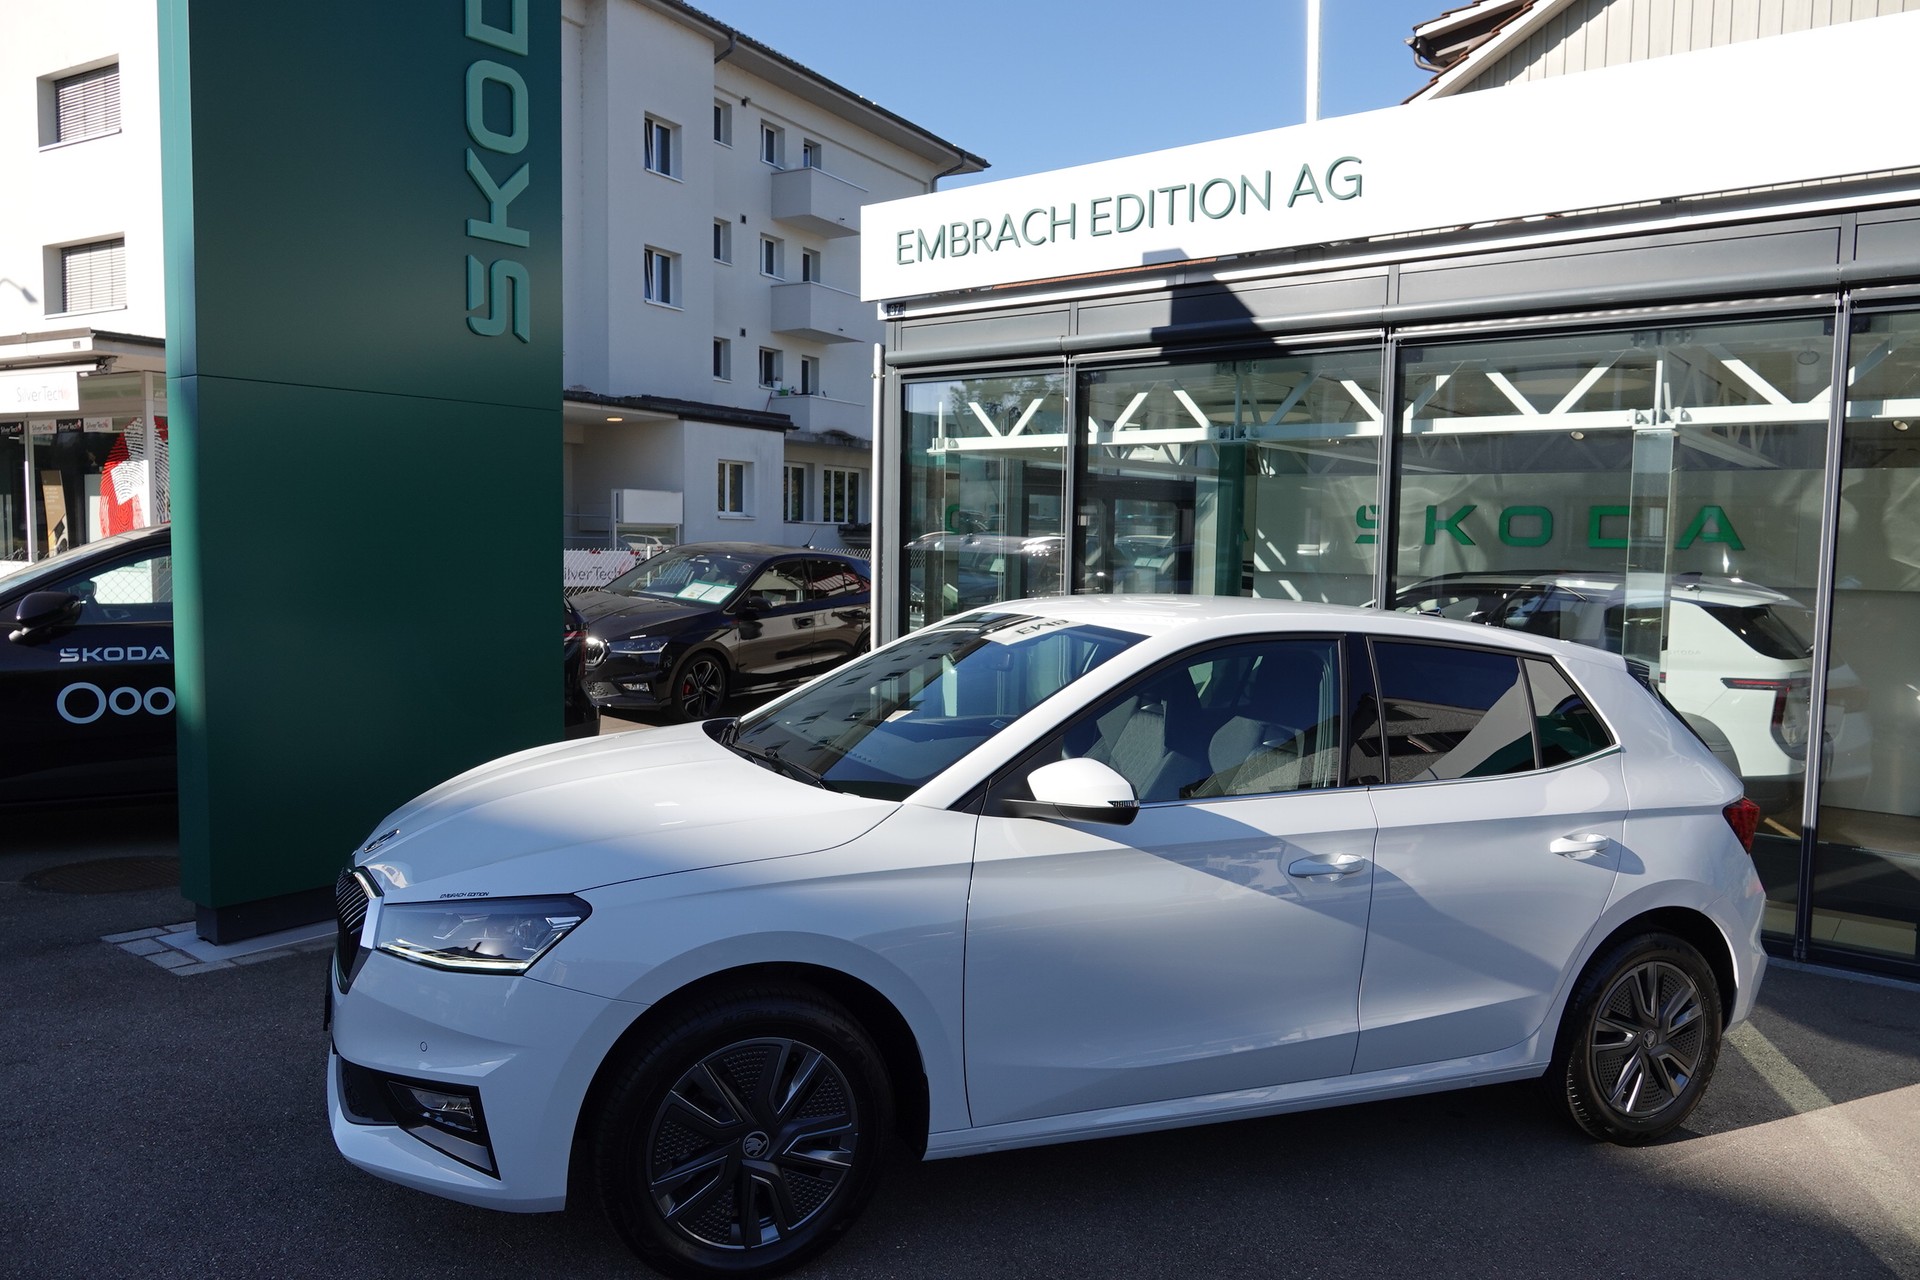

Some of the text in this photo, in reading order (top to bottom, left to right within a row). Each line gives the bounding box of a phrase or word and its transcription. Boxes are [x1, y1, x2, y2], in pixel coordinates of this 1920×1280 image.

[895, 156, 1363, 265] EMBRACH EDITION AG
[59, 645, 170, 662] SKODA
